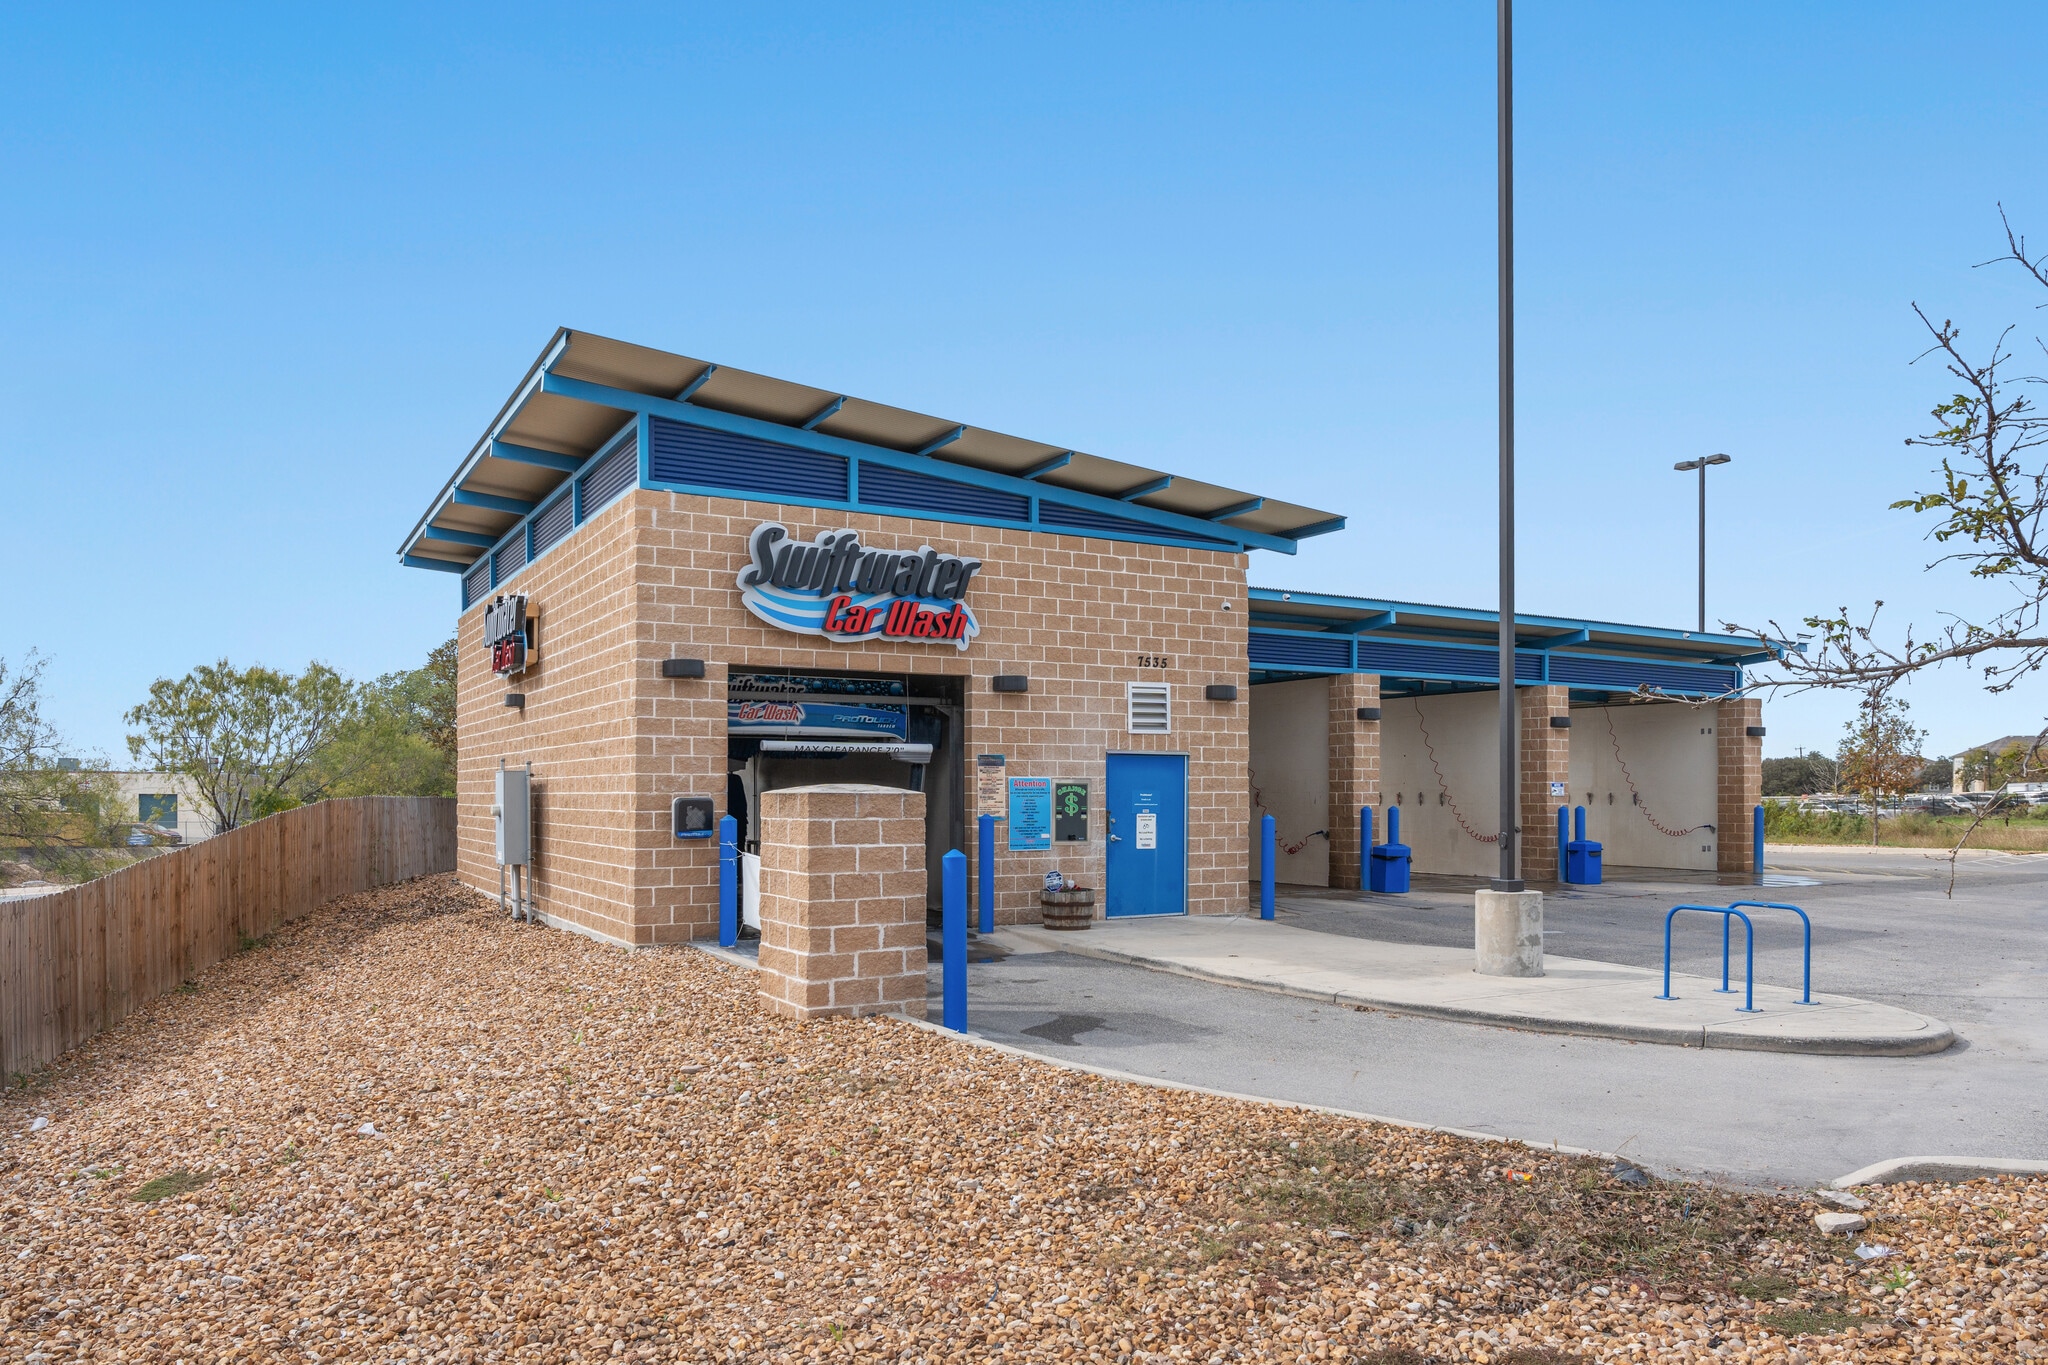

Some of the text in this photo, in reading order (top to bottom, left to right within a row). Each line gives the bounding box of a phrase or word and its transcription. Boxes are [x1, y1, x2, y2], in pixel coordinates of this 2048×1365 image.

[744, 527, 982, 600] Swiftwater
[822, 595, 969, 640] Car Wash
[1137, 656, 1168, 669] 7535
[738, 703, 799, 720] Car Wash
[822, 745, 882, 753] CLEARANCE
